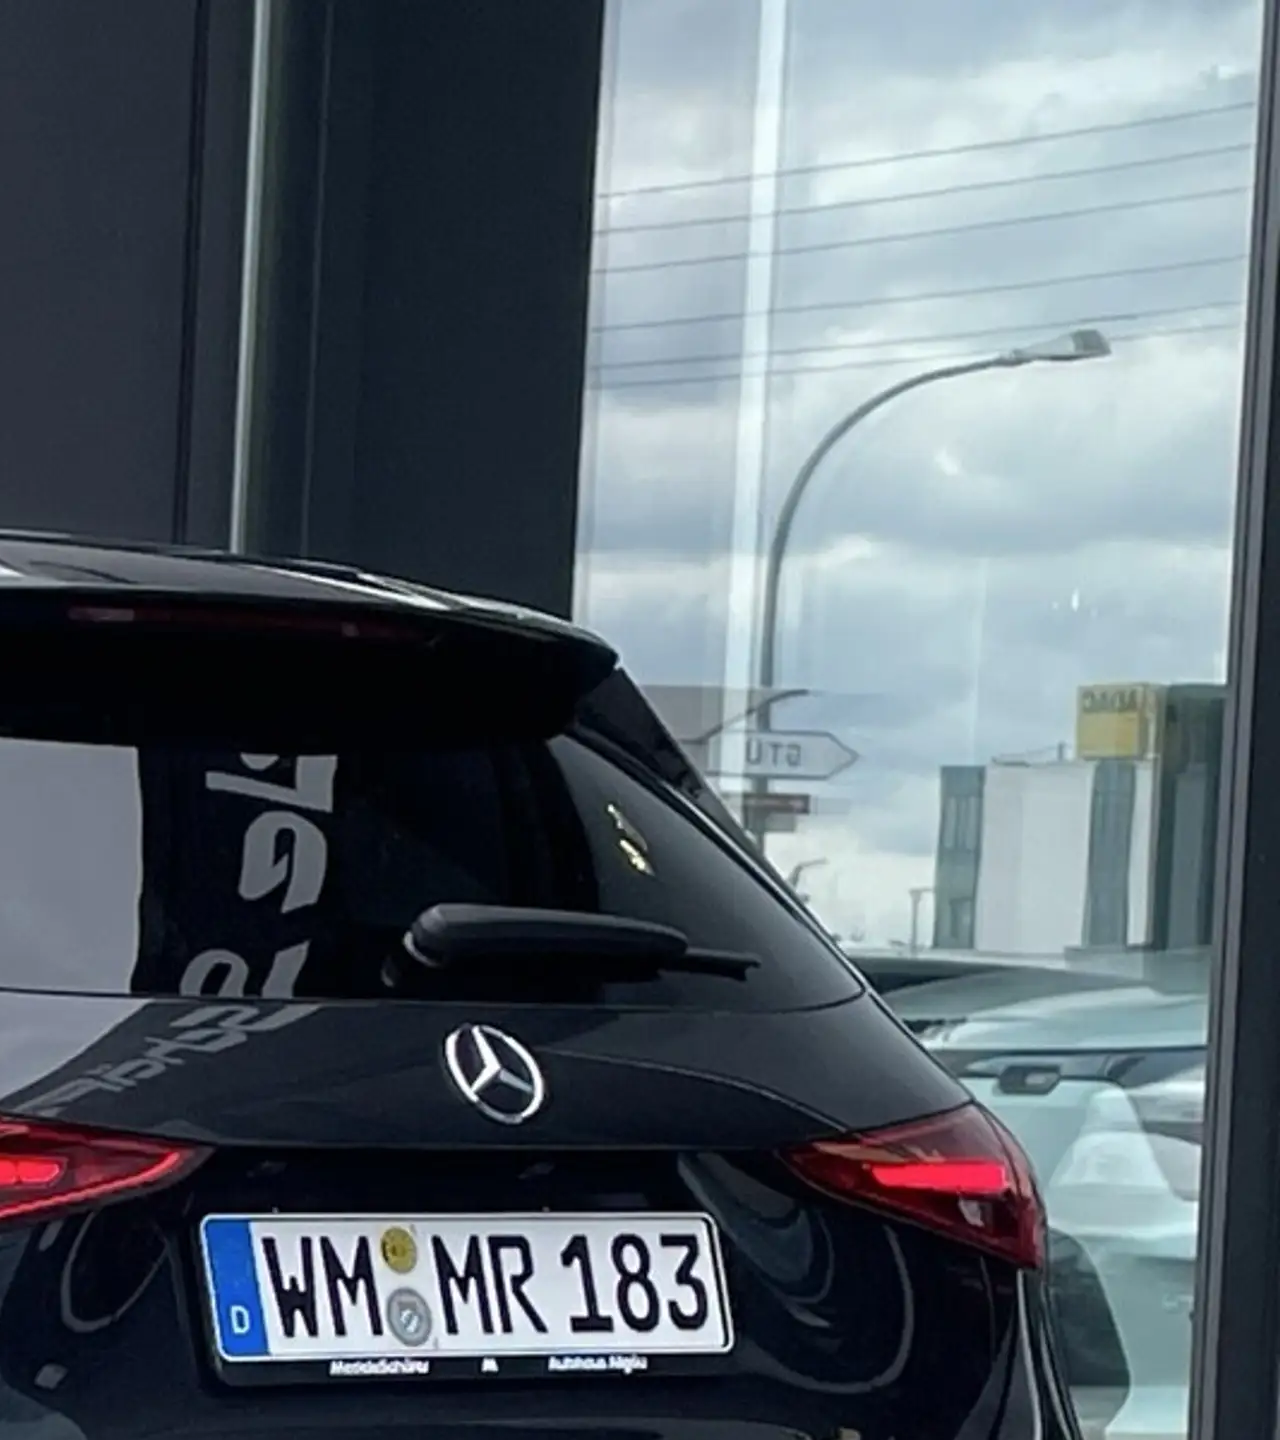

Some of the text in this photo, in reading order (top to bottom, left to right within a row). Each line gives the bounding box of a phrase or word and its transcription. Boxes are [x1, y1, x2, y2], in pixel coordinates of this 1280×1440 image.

[231, 1233, 708, 1339] D WM MR 183
